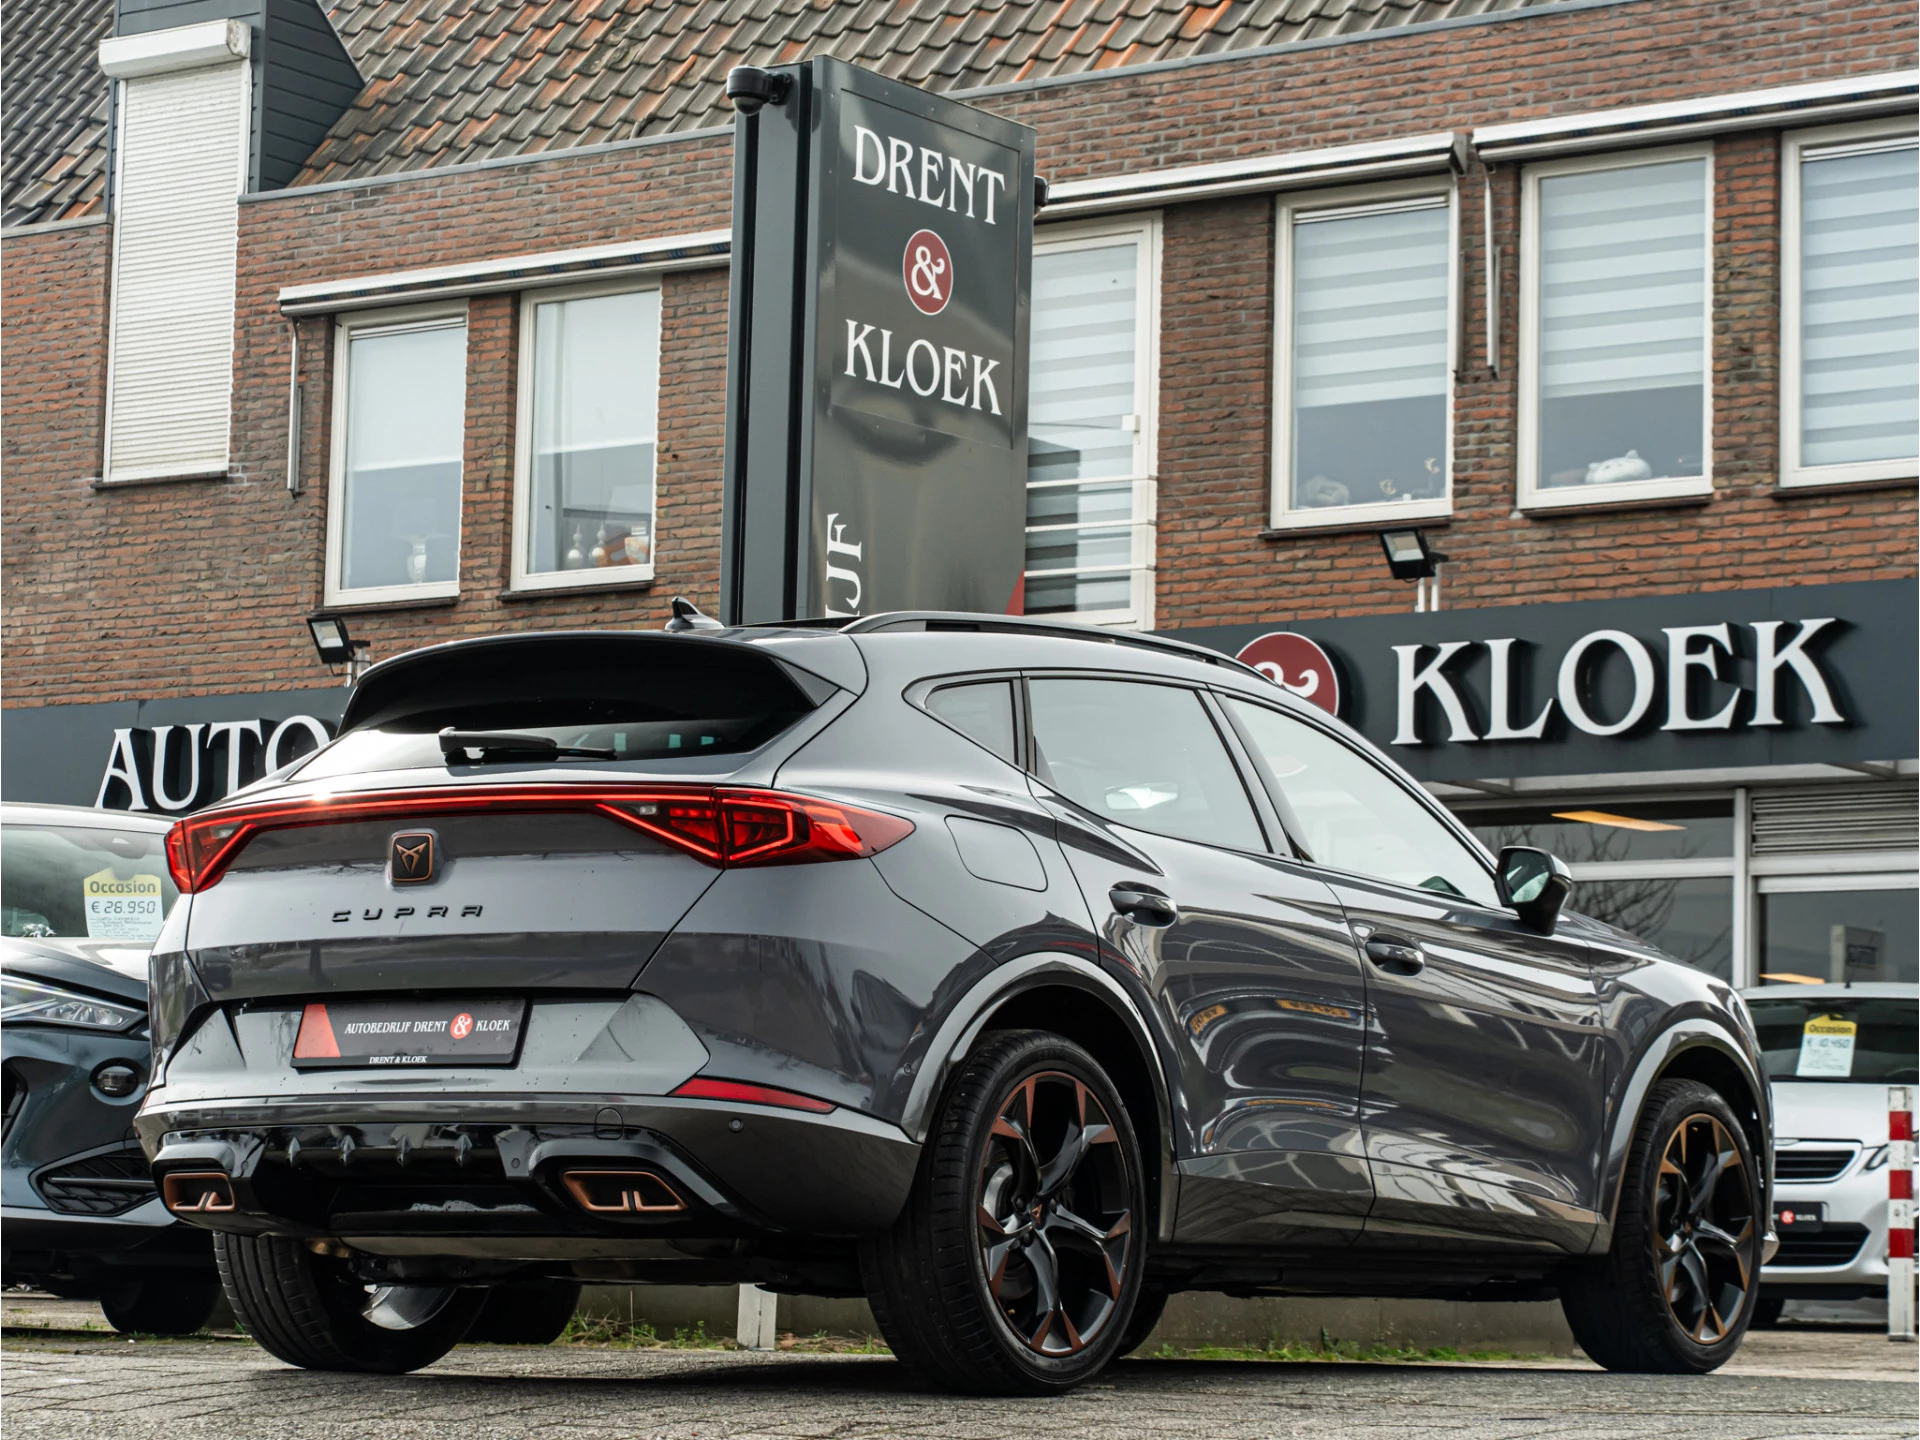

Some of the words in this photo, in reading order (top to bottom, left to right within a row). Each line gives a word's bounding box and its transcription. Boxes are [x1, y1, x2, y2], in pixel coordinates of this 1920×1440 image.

[853, 125, 1005, 225] DRENT
[911, 246, 945, 300] &
[844, 319, 1002, 416] KLOEK
[1390, 618, 1845, 746] KLOEK
[90, 881, 156, 893] Occasion
[91, 901, 100, 914] €
[332, 905, 483, 922] CUPRA
[344, 1021, 411, 1034] AUTOBEDRIJF
[413, 1020, 448, 1033] DRENT
[453, 1015, 472, 1035] &
[475, 1019, 511, 1032] KLOEK
[1808, 1024, 1852, 1034] Occasion
[369, 1056, 394, 1064] DRENT
[394, 1056, 401, 1064] &
[401, 1055, 428, 1064] KLOEK
